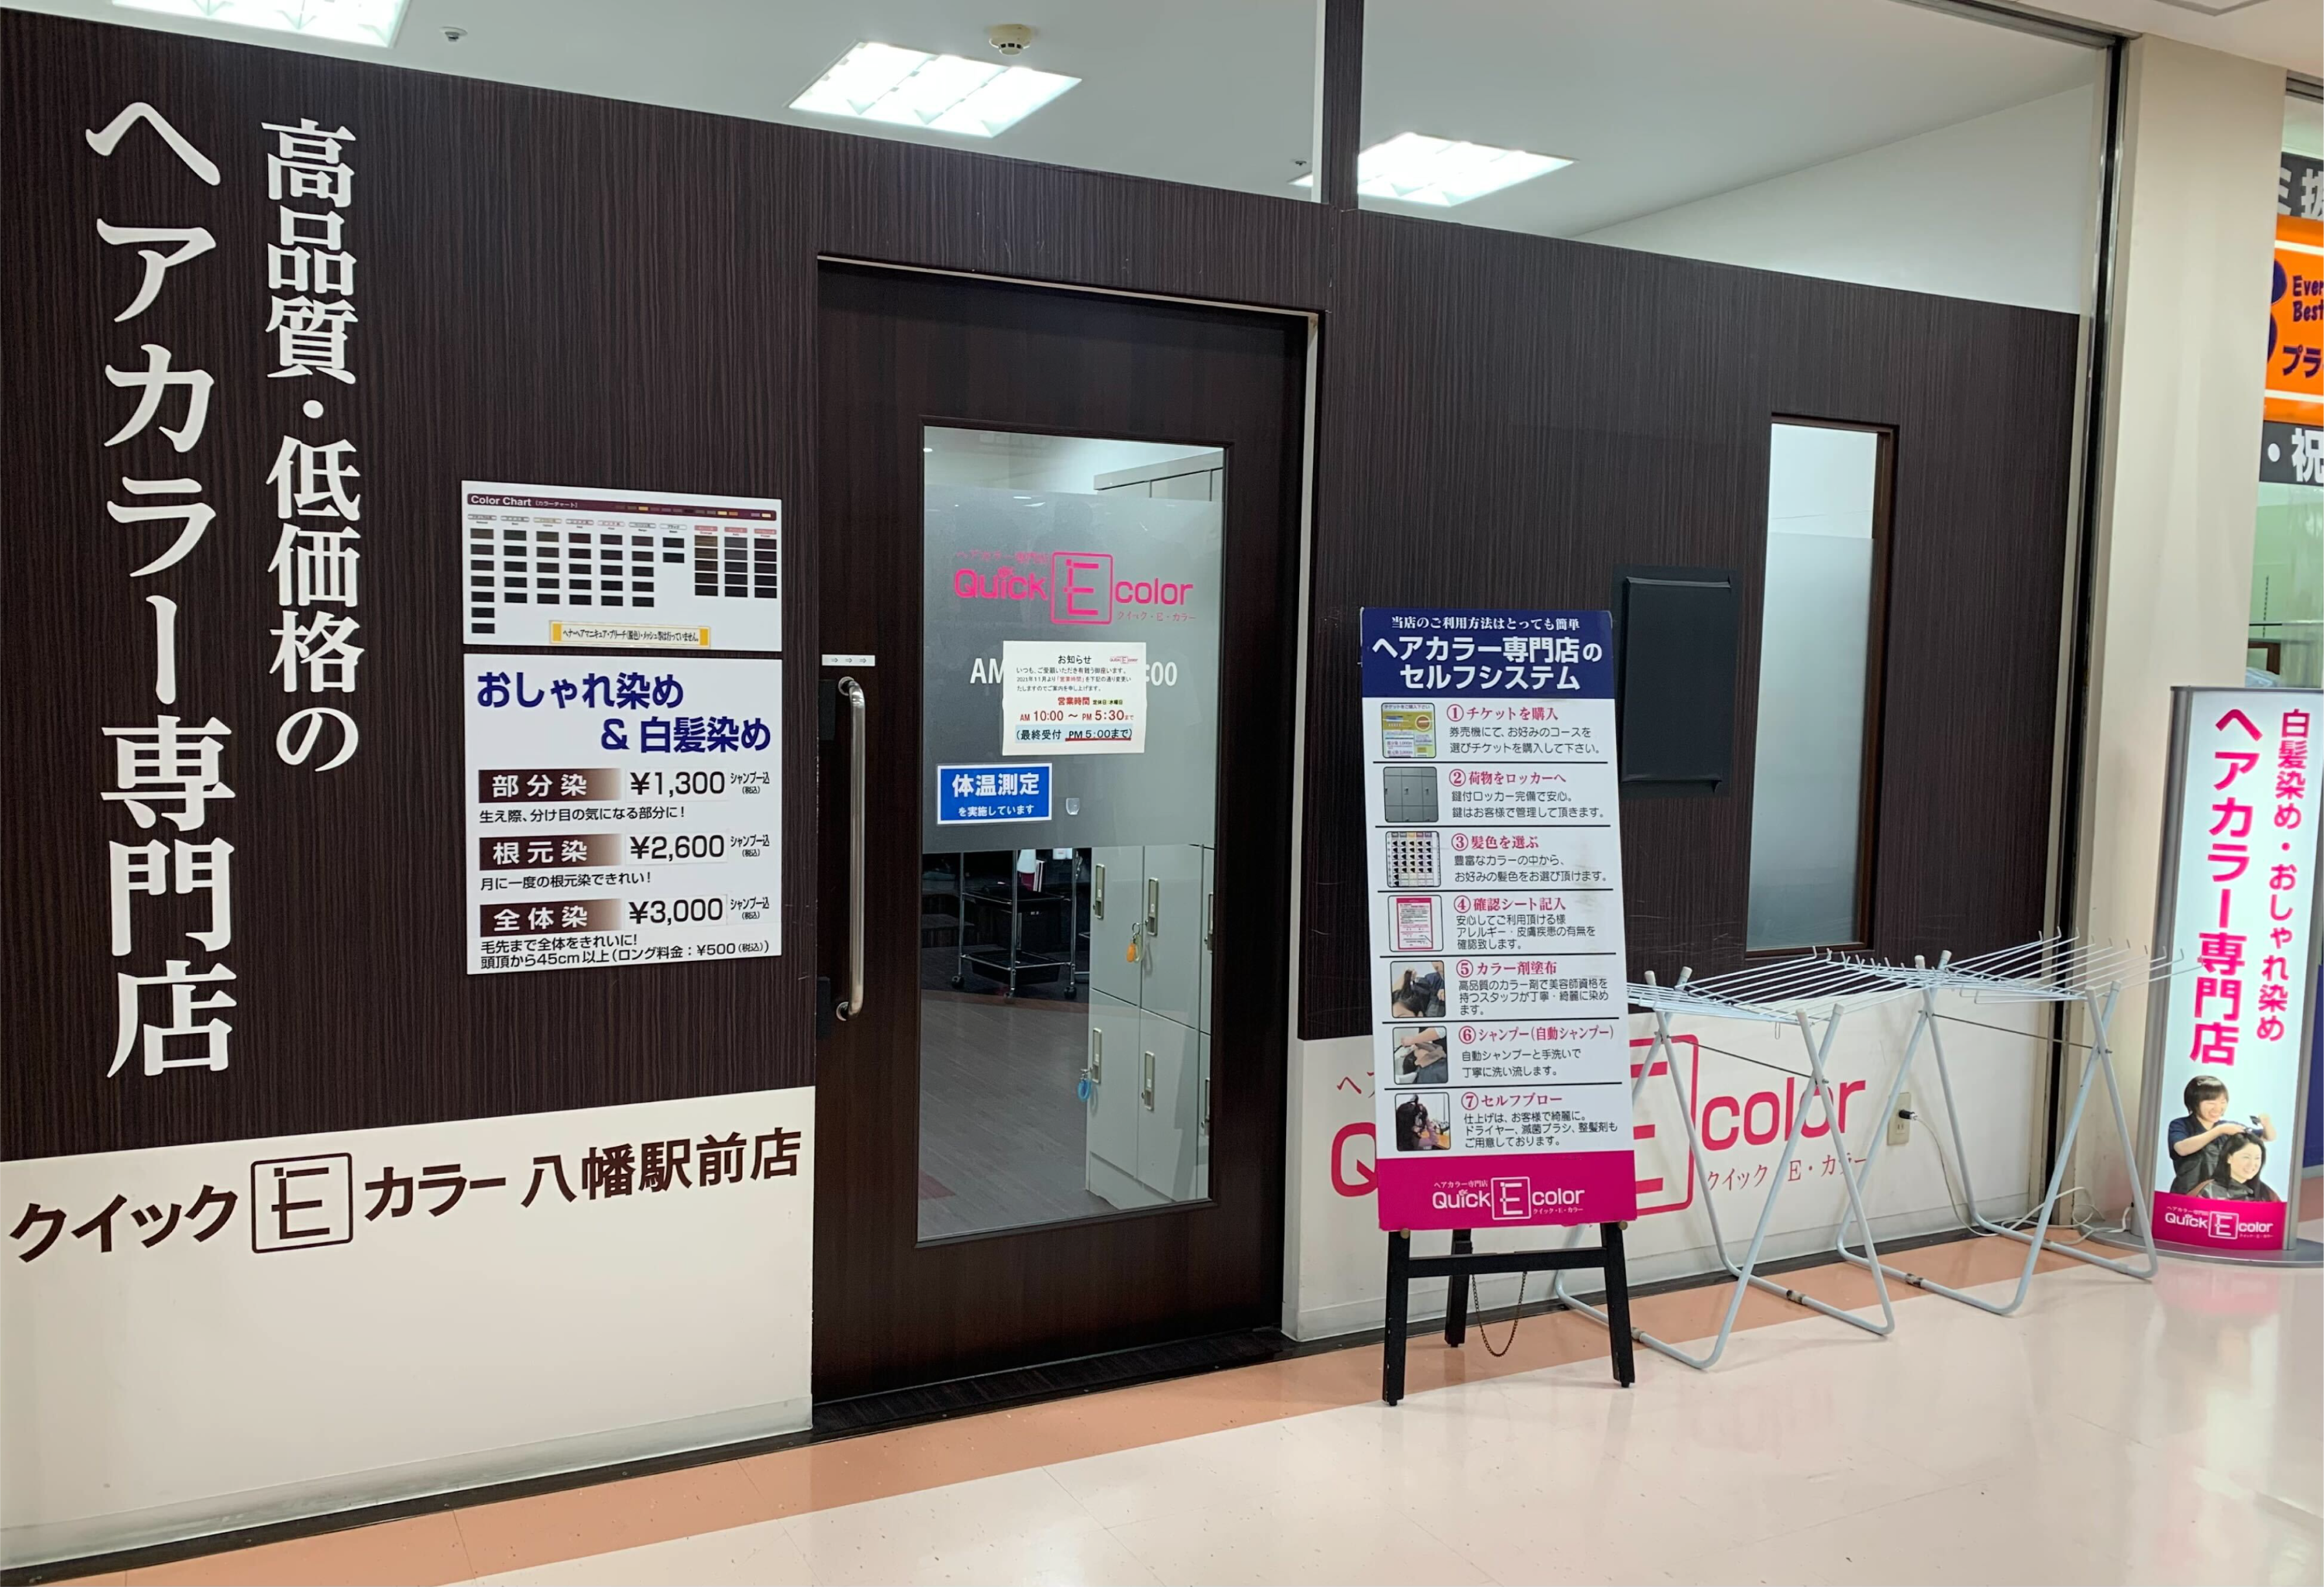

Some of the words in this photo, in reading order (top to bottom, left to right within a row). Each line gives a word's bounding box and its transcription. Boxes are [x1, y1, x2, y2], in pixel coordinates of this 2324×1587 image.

[2282, 345, 2324, 379] プラ
[260, 118, 365, 771] 高品質・低価格の
[471, 494, 500, 505] Color
[503, 496, 531, 507] Chart
[85, 102, 237, 1078] ヘアカラー専門店
[954, 566, 1048, 601] Quick
[1115, 578, 1194, 605] color
[1391, 615, 1581, 632] 当店のご利用方法はとっても簡単
[1371, 635, 1604, 664] ヘアカラー専門店の
[1057, 655, 1092, 665] お知らせ
[1399, 665, 1581, 690] セルフシステム
[476, 672, 684, 710] おしゃれ染め
[1057, 697, 1091, 706] 営業時間
[1019, 713, 1030, 721] AM
[1033, 710, 1064, 721] 10:00
[640, 716, 772, 753] 白髪染め
[1449, 726, 1592, 738] 券売機にて、お好みのコースを
[1449, 742, 1600, 755] 選びチケットを購入して下さい。
[492, 773, 587, 798] 部分染
[630, 771, 726, 798] ¥1,300
[951, 772, 1040, 798] 体温測定
[479, 806, 686, 824] 生え際、分け目の気になる部分に！
[957, 804, 1035, 818] を実施しています
[1452, 806, 1604, 819] 鍵はお客様で管理して頂きます。
[492, 839, 588, 866] 根元染
[630, 834, 725, 862] ¥2,600
[1454, 854, 1565, 867] 豊富なカラーの中から、
[480, 872, 651, 891] 月に一度の根元染できれい！
[1455, 870, 1607, 883] お好みの髪色をお選び頂けます。
[2256, 708, 2312, 1042] 白髪染め・おしゃれ染め
[2189, 708, 2264, 1066] ヘアカラー専門店
[493, 905, 589, 931] 全体染
[628, 897, 724, 926] ¥3,000
[1456, 914, 1566, 927] 安心してご利用頂ける様
[480, 933, 638, 955] 毛先まで全体をきれいに！
[1457, 938, 1522, 950] 確認致します。
[1458, 978, 1608, 991] 高品質のカラー剤で美容師資格を
[1459, 991, 1609, 1003] 持つスタッフが丁寧・綺麗に染め
[1459, 1004, 1484, 1016] ます。
[1462, 1048, 1582, 1062] 自動シャンプーと手洗いで
[1462, 1065, 1558, 1079] 丁寧に洗い流します。
[1463, 1110, 1586, 1124] 仕上げは、お客様で綺麗に。
[1465, 1121, 1618, 1136] ドライヤー、滅菌ブラシ、整髪剤も
[1464, 1136, 1560, 1149] ご用意しております。
[521, 1126, 803, 1209] 八幡駅前店
[1432, 1189, 1491, 1210] Quick
[1532, 1187, 1585, 1206] color
[2165, 1212, 2209, 1229] Quick
[2238, 1221, 2274, 1234] color
